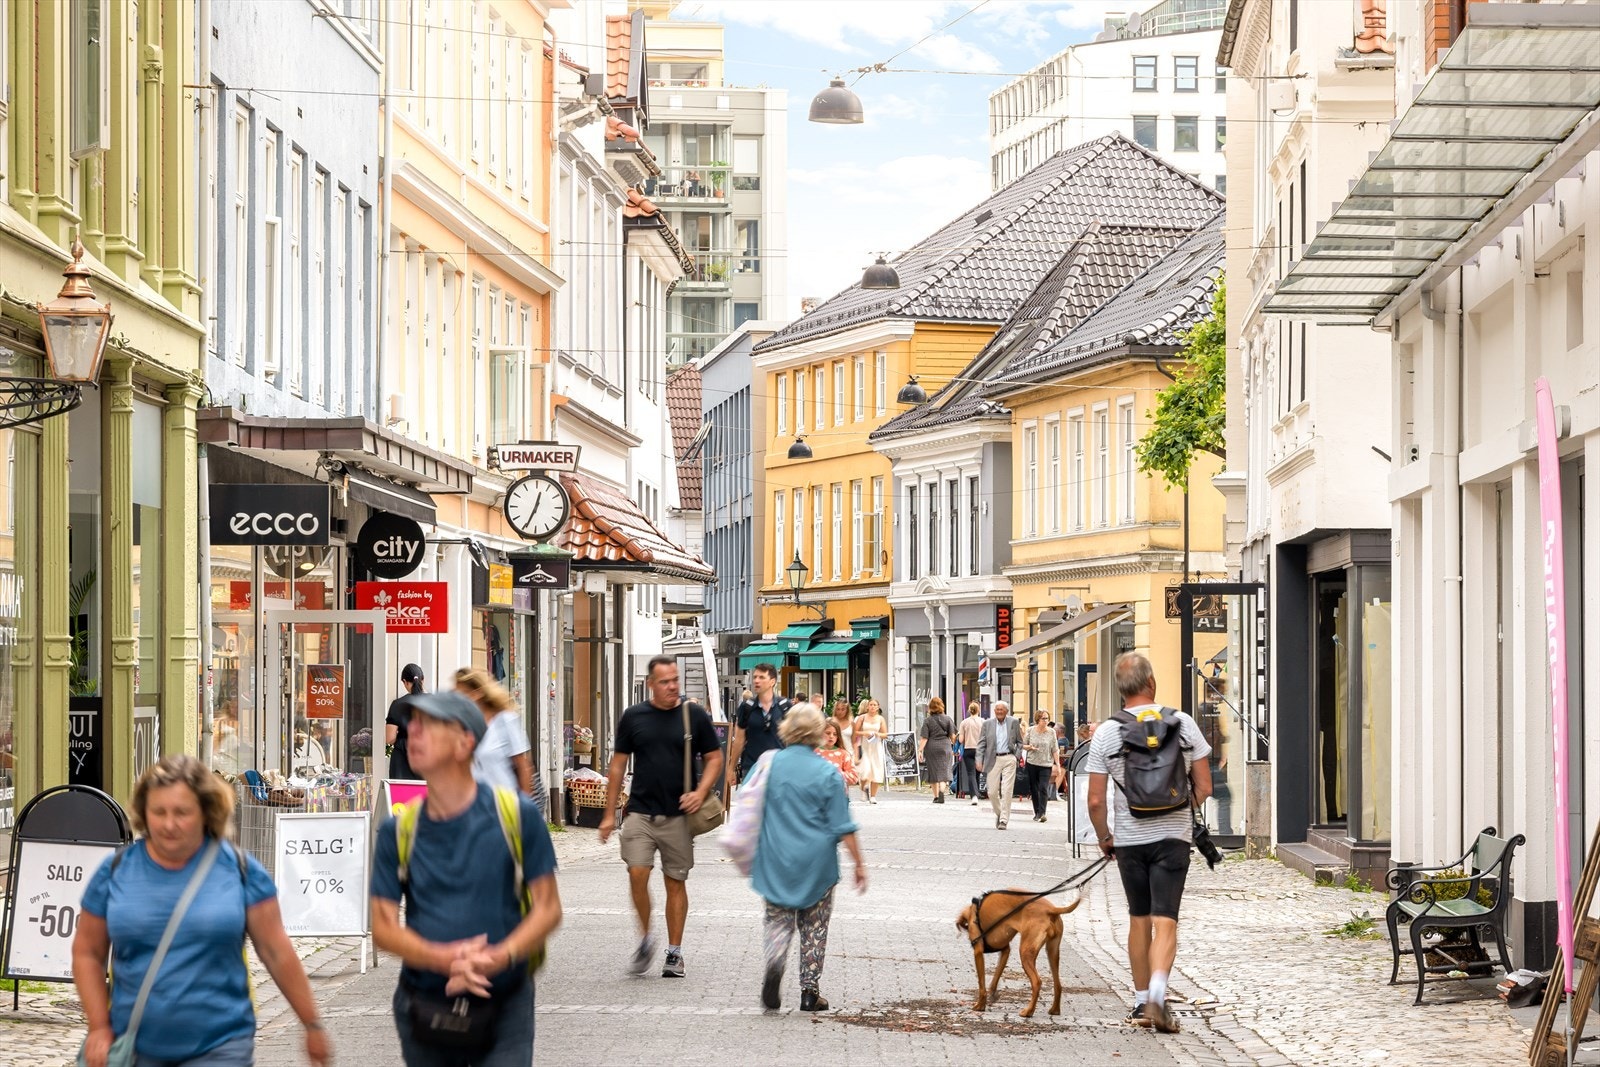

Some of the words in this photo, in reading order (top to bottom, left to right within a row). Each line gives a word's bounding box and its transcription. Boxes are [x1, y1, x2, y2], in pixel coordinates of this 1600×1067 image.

[501, 450, 574, 464] URMAKER
[229, 512, 319, 537] ecco
[372, 535, 420, 563] city
[397, 589, 422, 600] fashion
[423, 590, 433, 602] by
[1197, 617, 1225, 628] AL
[310, 685, 340, 695] SALG
[315, 698, 335, 706] 50%
[47, 864, 83, 882] SALG
[300, 878, 344, 895] 70%
[29, 894, 41, 905] OPP
[41, 891, 51, 900] TIL
